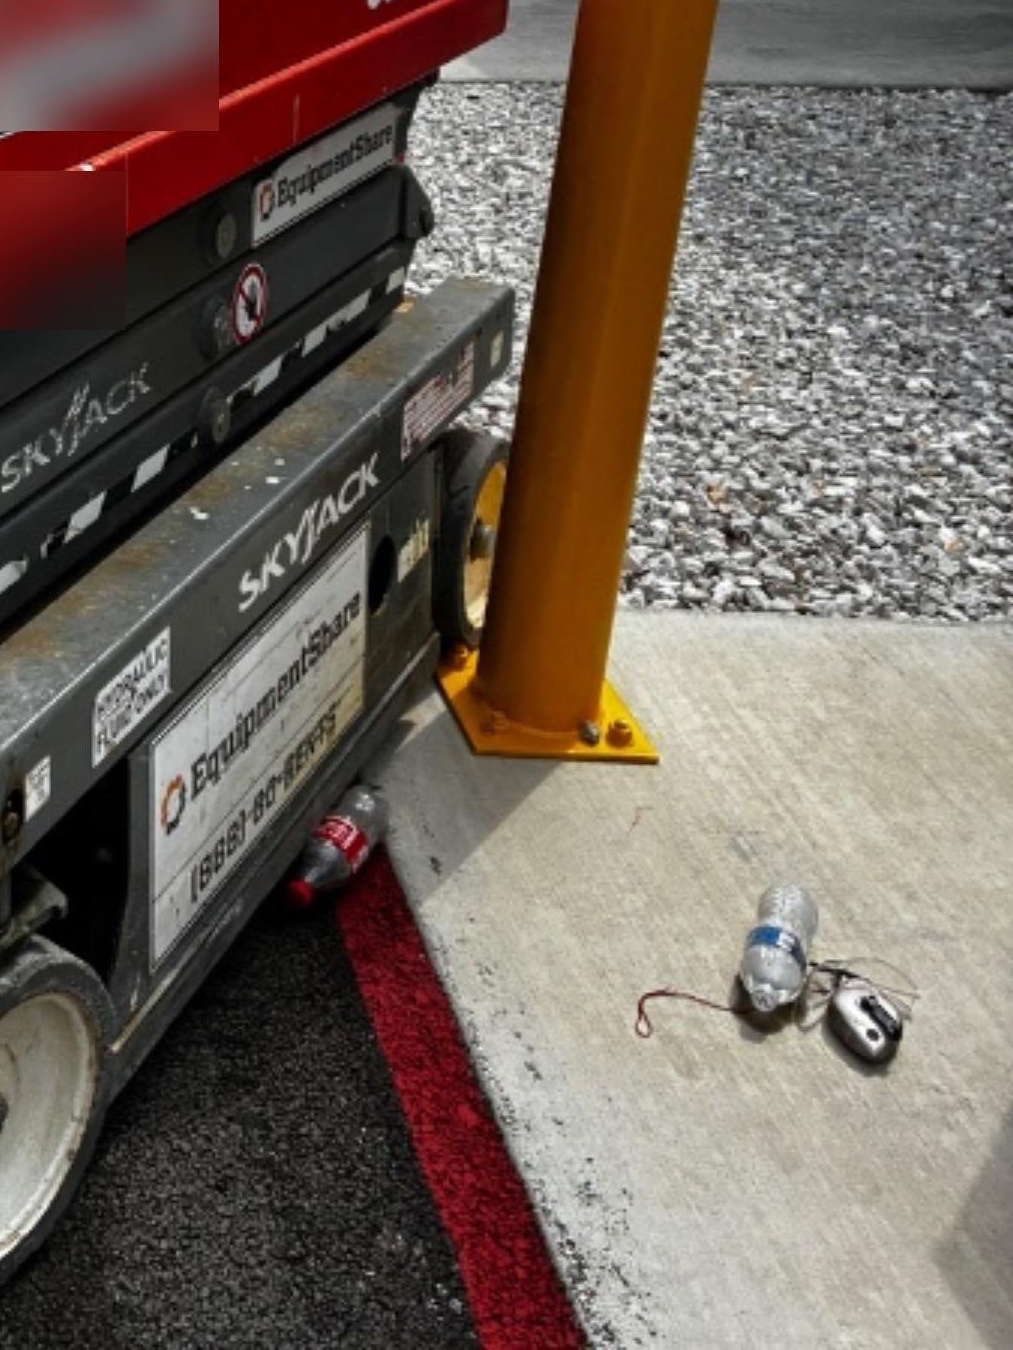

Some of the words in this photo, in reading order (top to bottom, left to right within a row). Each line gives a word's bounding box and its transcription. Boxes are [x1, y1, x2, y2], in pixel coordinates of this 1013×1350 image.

[277, 125, 392, 208] EquipmentShare
[1, 361, 151, 494] SKYJACK
[238, 451, 380, 613] SKYJACK
[191, 592, 361, 800] EquipmentShare
